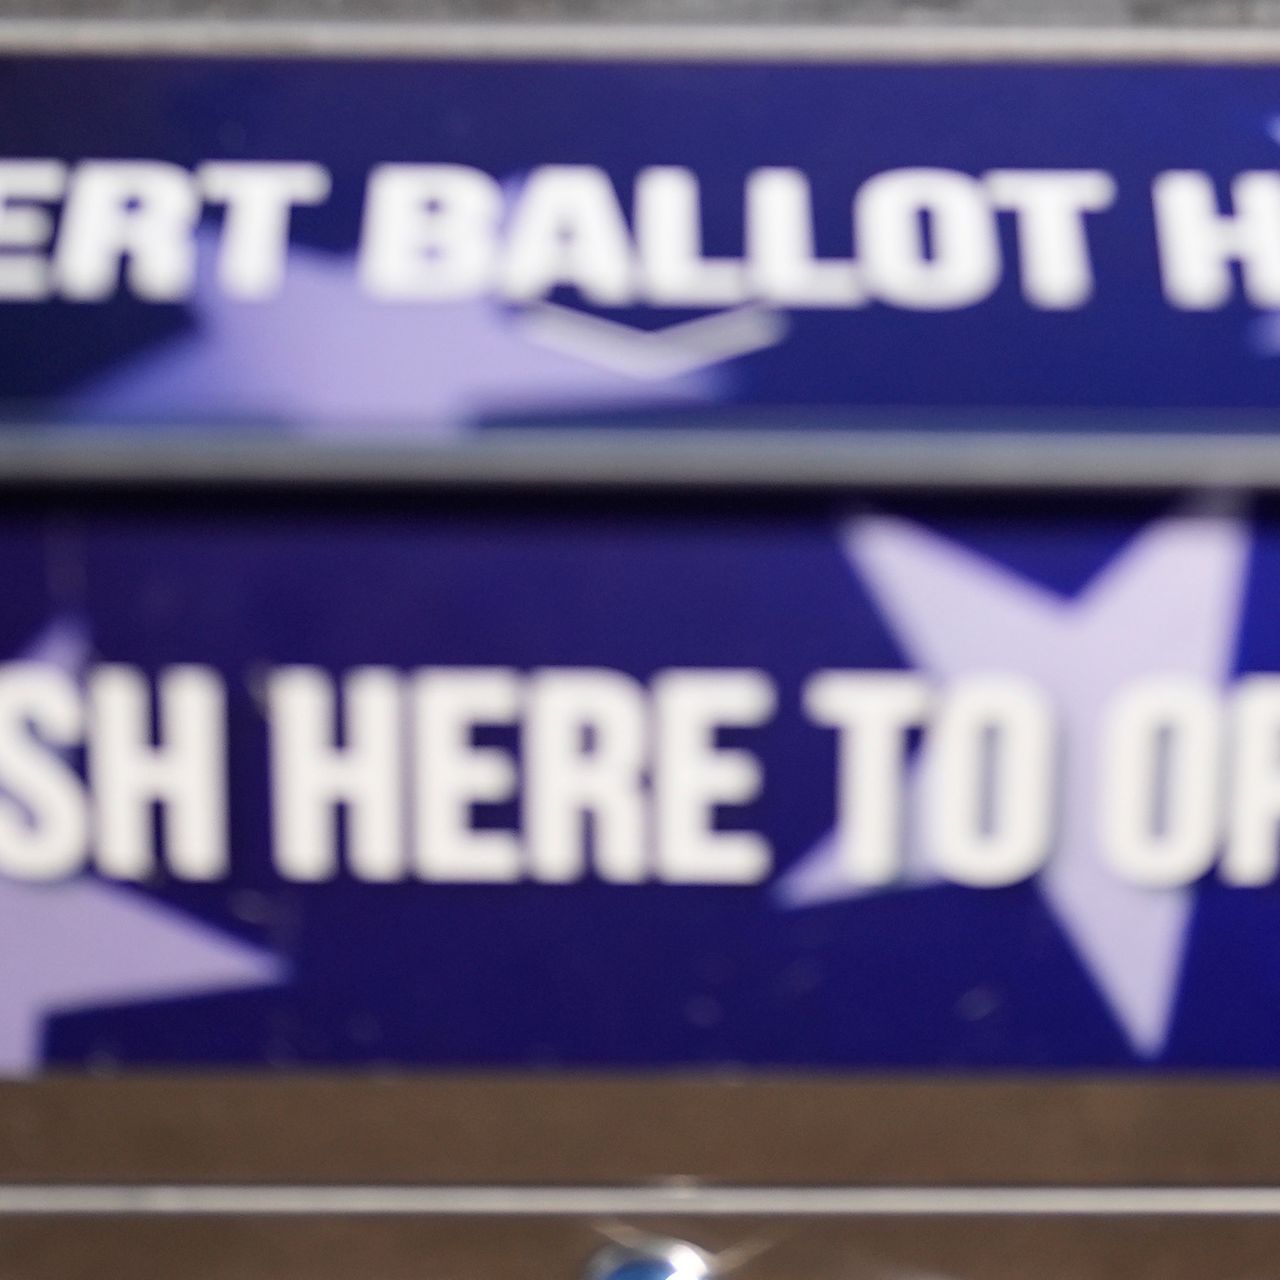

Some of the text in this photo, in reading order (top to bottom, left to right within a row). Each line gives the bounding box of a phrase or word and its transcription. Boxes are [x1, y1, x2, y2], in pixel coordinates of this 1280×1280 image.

[360, 161, 1117, 312] BALLOT
[267, 663, 777, 886] HERE
[802, 668, 1058, 889] TO
